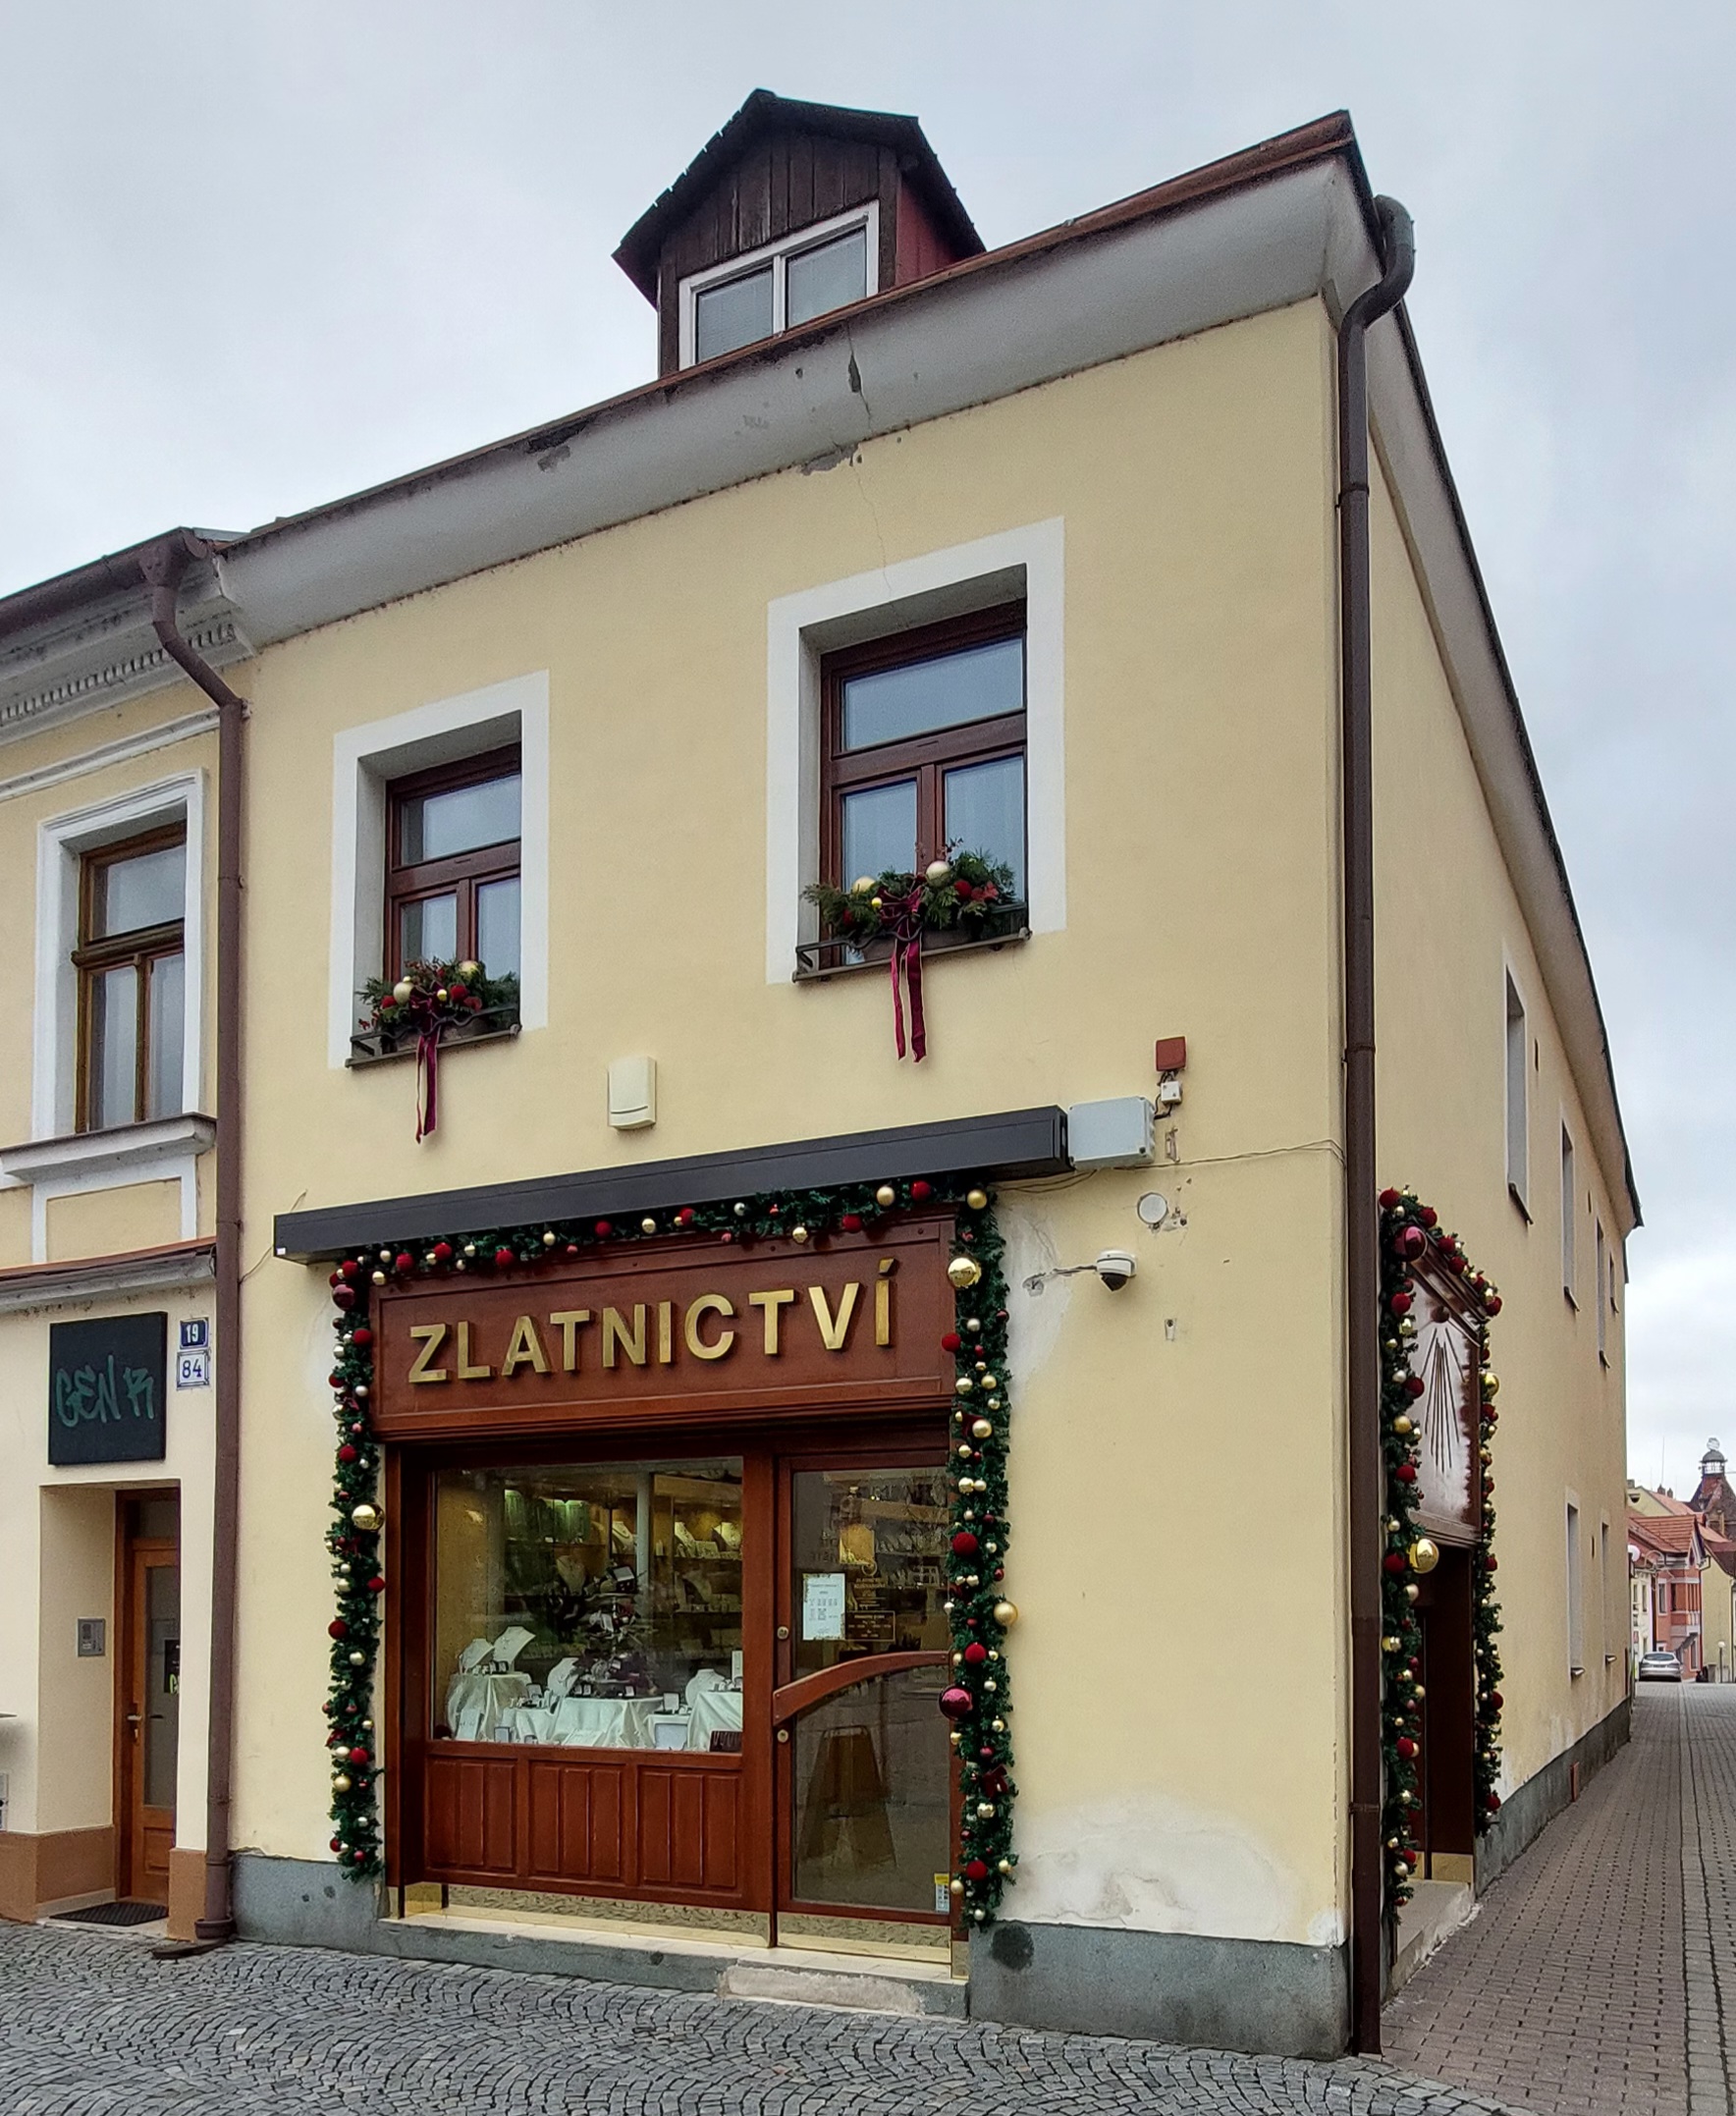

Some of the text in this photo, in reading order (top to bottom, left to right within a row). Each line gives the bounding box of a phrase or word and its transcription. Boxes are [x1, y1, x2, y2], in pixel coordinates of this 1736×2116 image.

[408, 1258, 897, 1384] ZLATNICTVÍ
[186, 1323, 199, 1343] 19
[182, 1359, 202, 1379] 84
